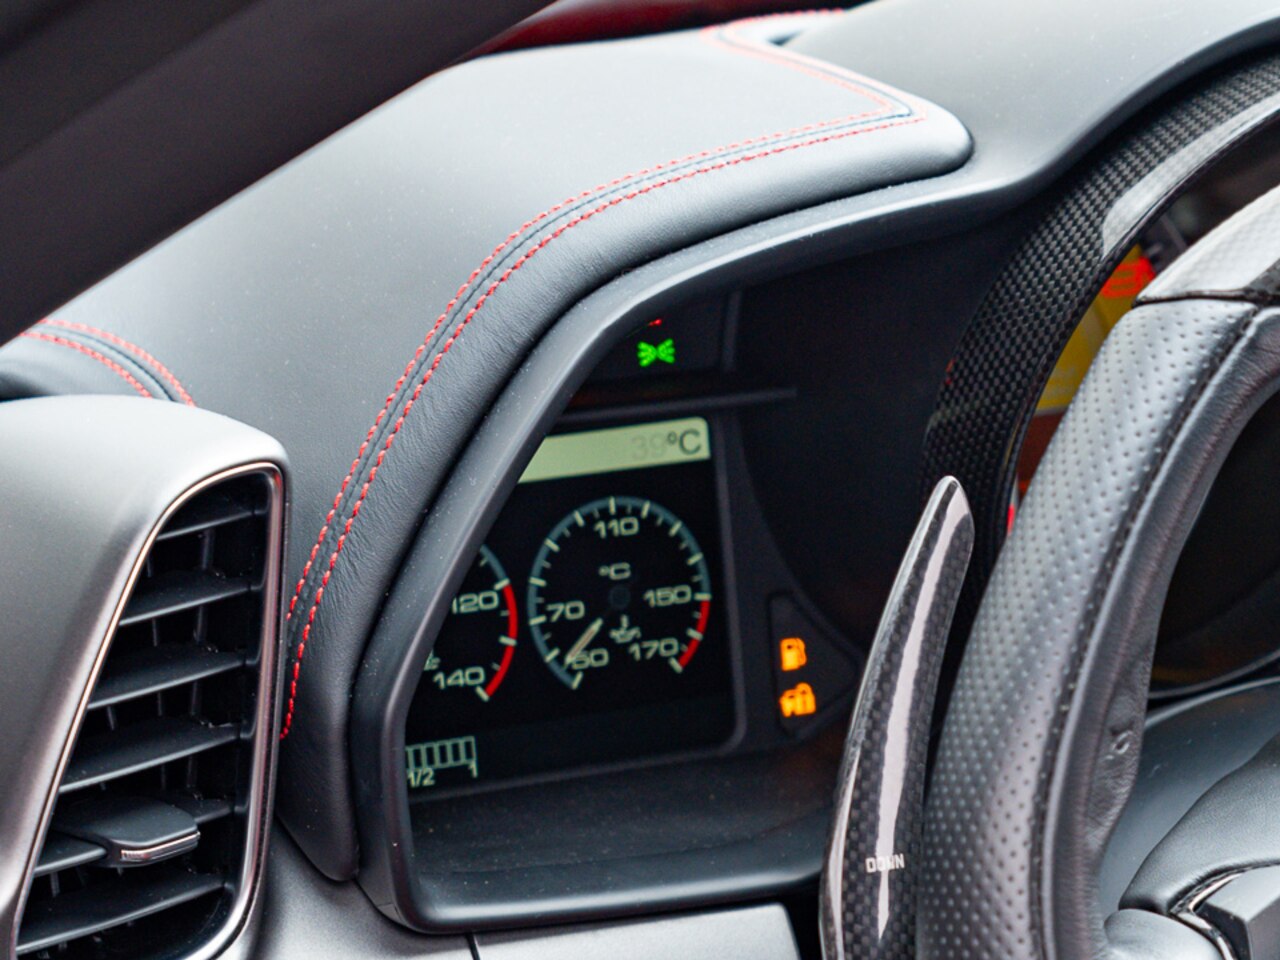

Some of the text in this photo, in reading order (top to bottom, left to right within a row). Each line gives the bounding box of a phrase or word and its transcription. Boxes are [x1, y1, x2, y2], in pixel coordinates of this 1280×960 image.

[594, 516, 640, 539] 110
[452, 590, 499, 615] 120
[643, 584, 693, 607] 150
[546, 600, 586, 622] 70
[629, 637, 680, 661] 170
[432, 666, 486, 690] 140
[407, 767, 436, 788] 1/2
[865, 853, 906, 874] DOWN
